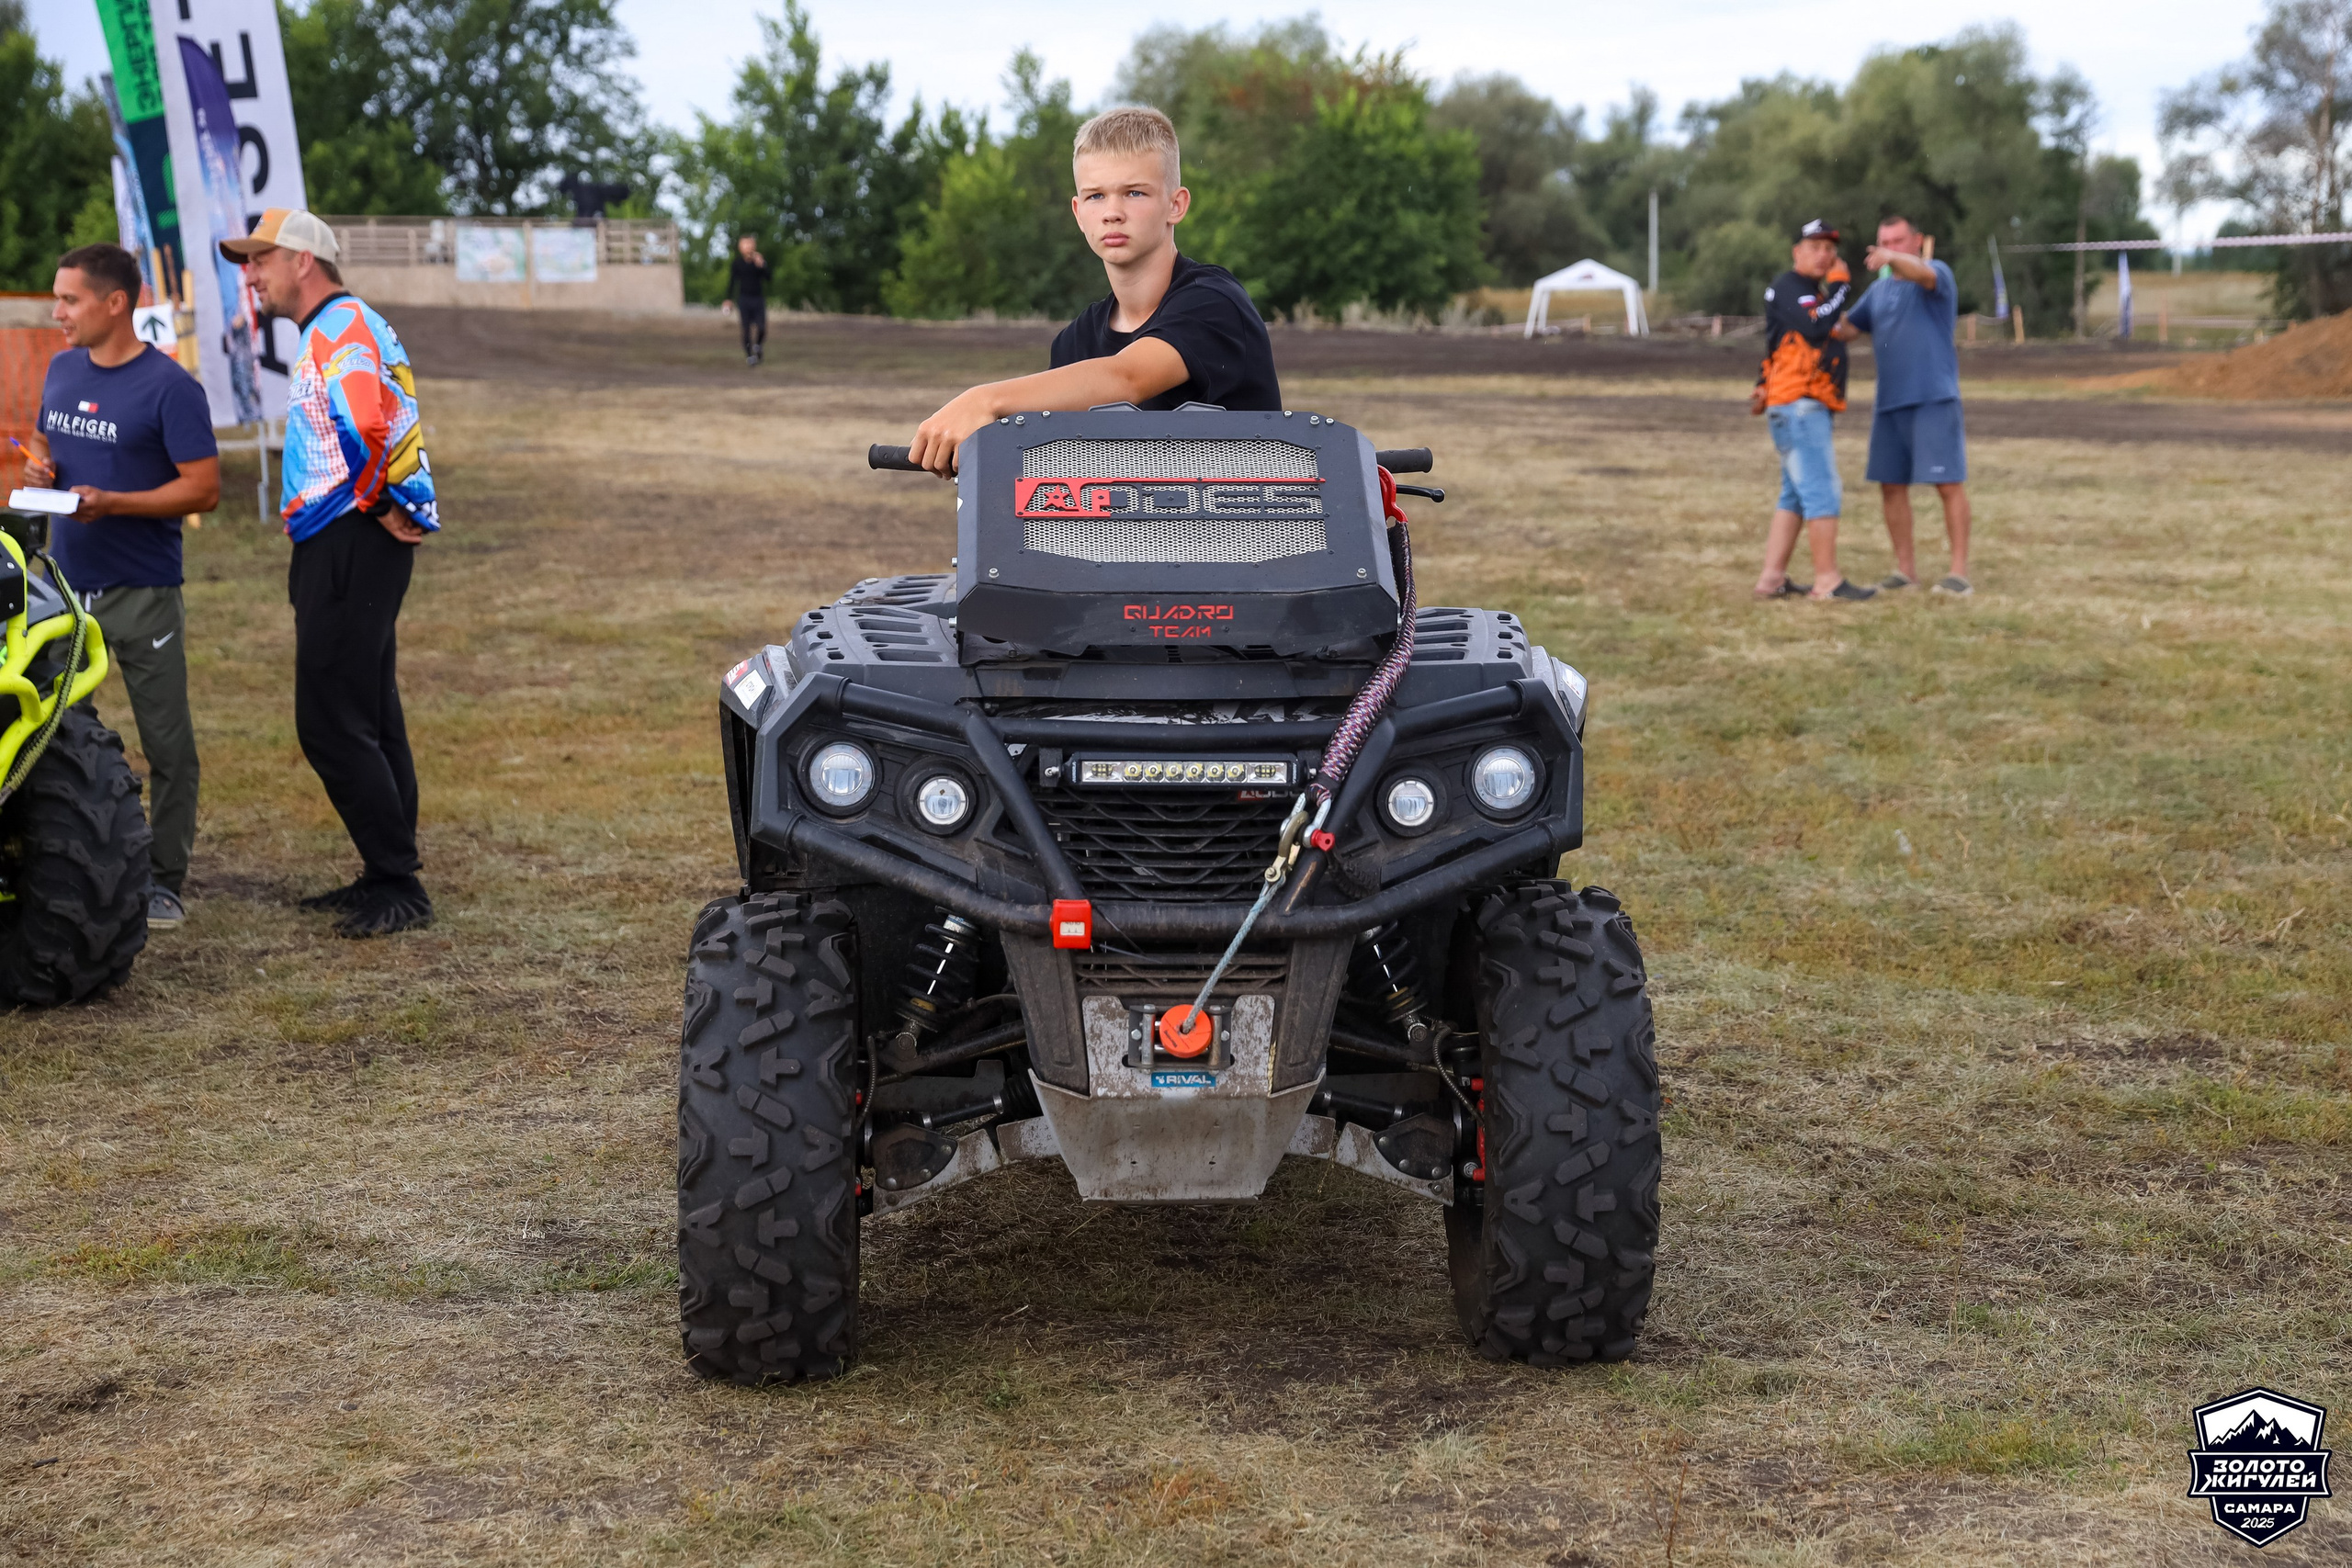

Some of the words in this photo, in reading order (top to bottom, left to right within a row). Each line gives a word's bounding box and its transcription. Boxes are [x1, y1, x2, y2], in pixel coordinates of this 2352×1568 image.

[47, 410, 118, 438] HILFIGER
[1124, 604, 1234, 620] QUADRO
[1148, 626, 1211, 637] TEAM
[1166, 1075, 1211, 1084] RIVAL
